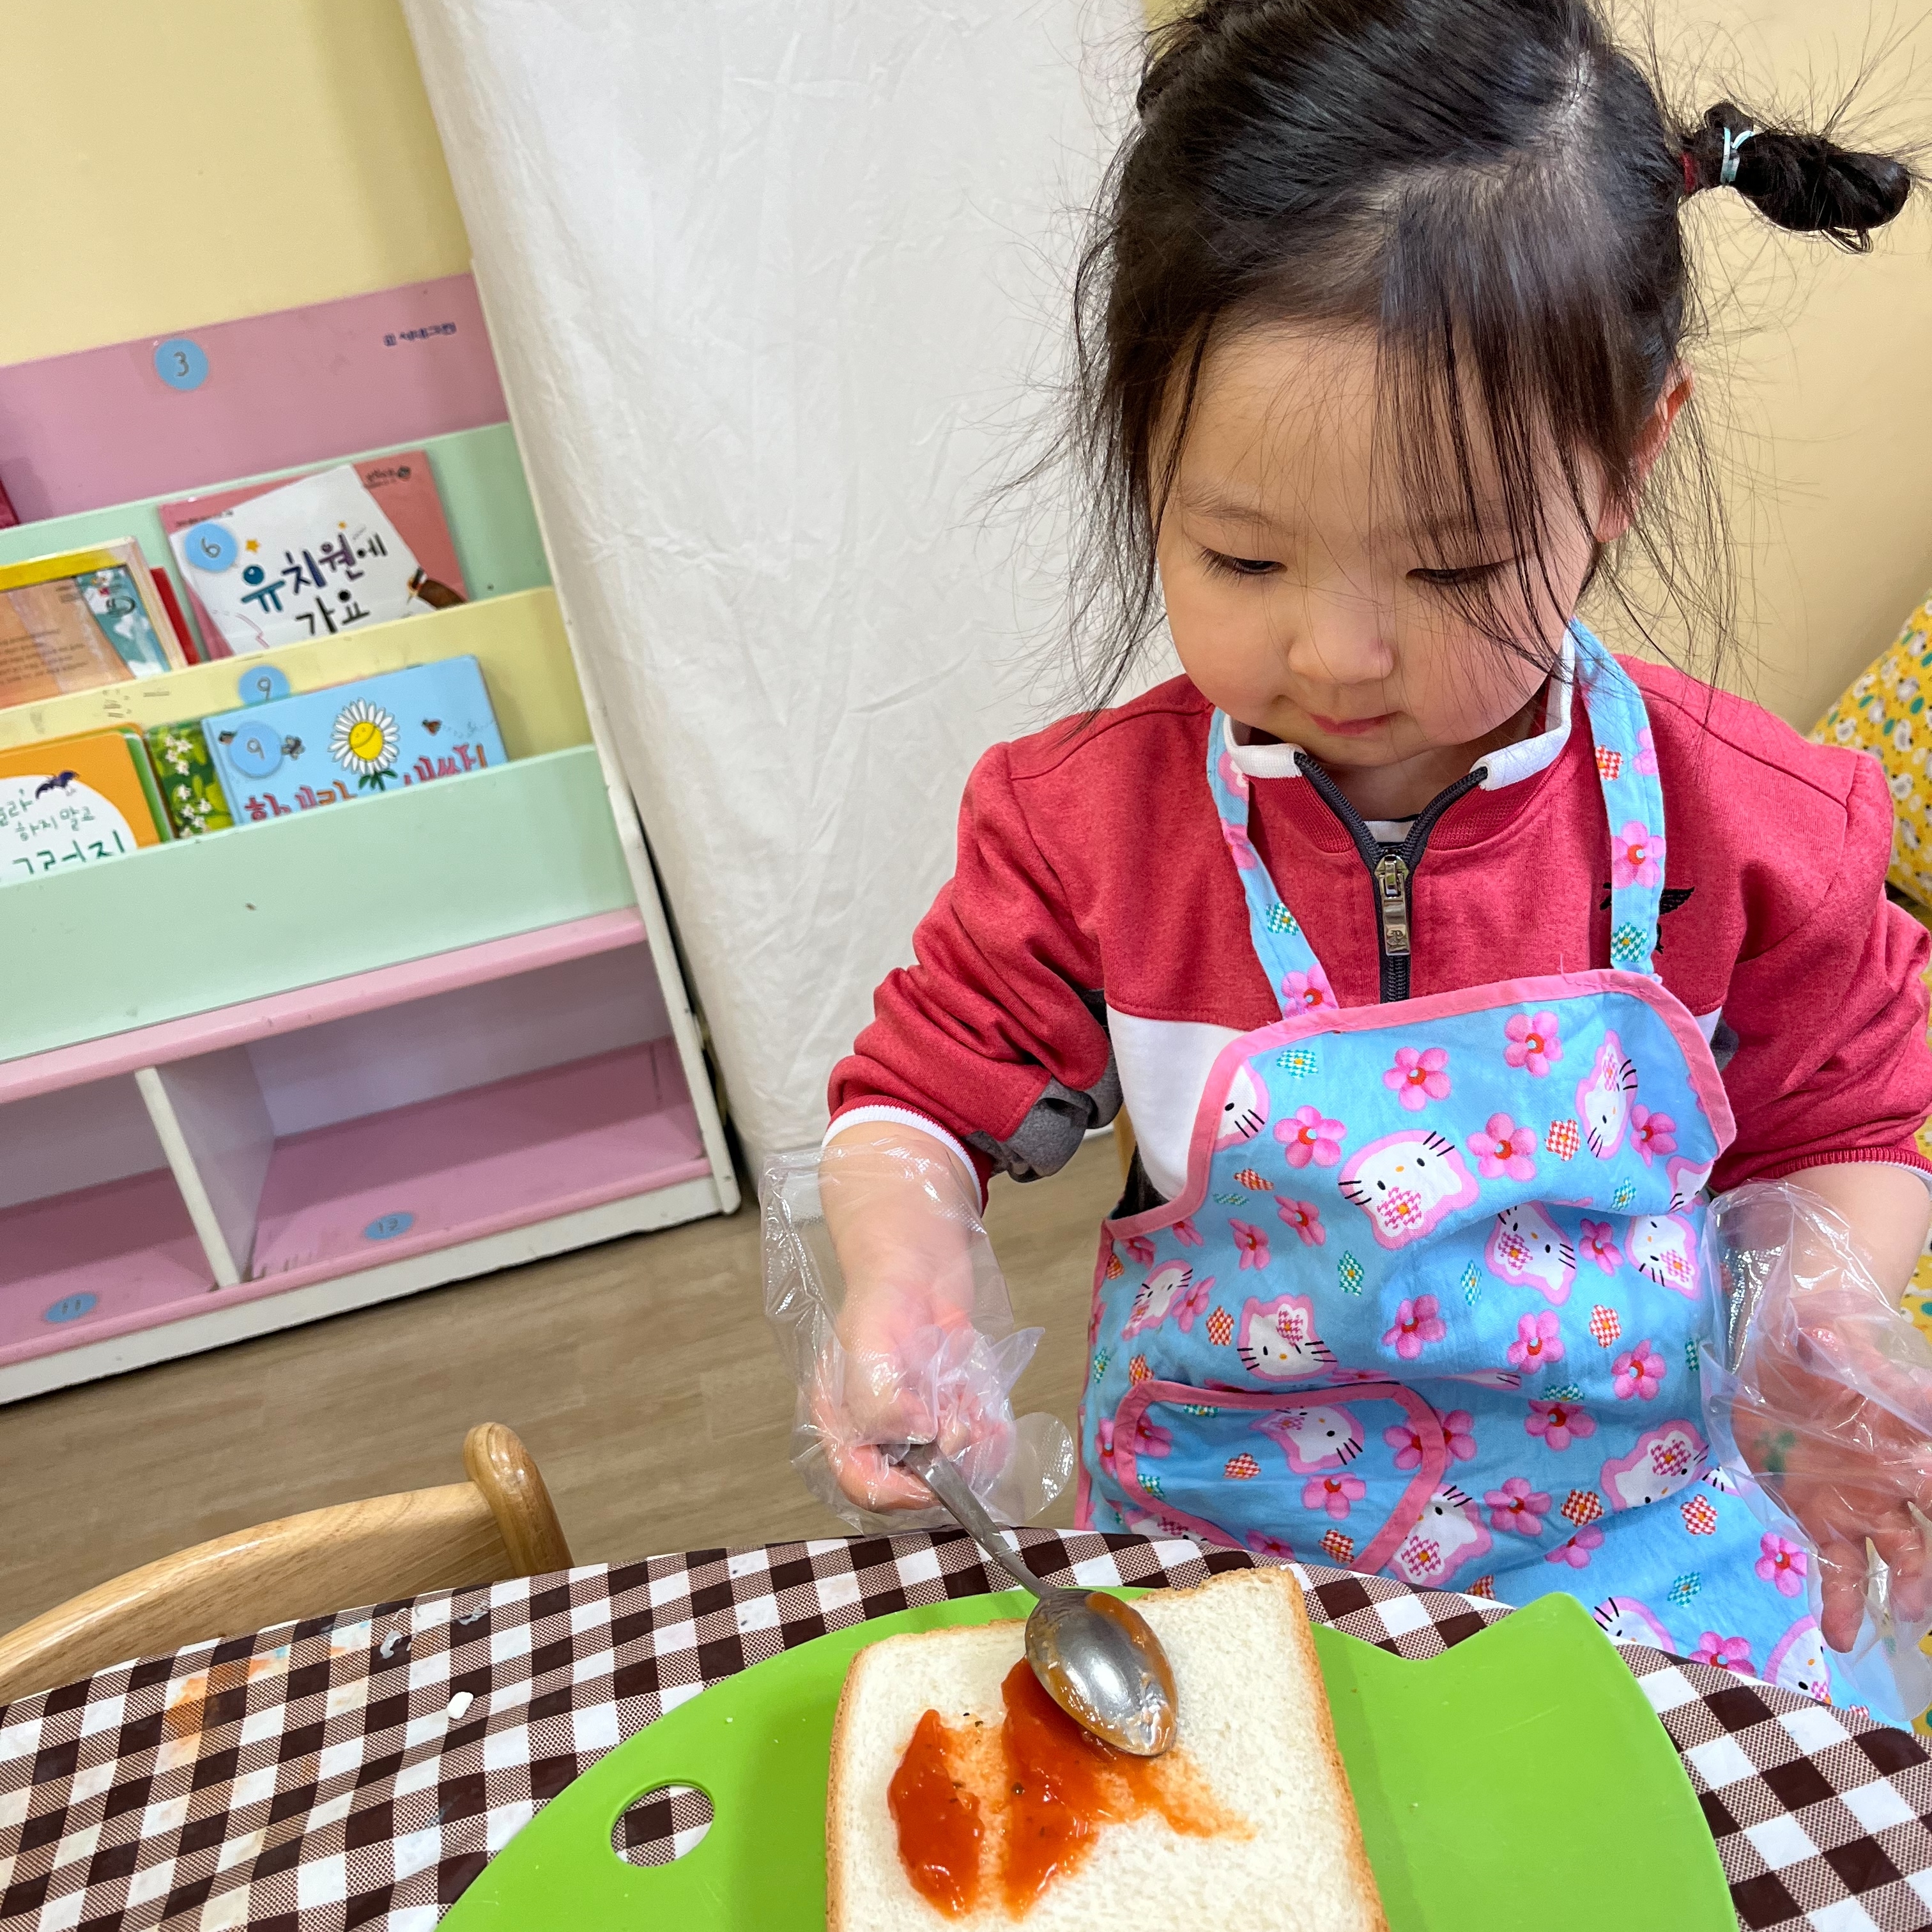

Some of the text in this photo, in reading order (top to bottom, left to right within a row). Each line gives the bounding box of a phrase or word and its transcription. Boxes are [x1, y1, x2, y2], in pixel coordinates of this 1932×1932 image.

[173, 351, 189, 377] 3
[200, 536, 222, 558] 6
[241, 532, 388, 613] 유치원에
[295, 589, 371, 635] 가요
[257, 676, 271, 702] 9
[247, 738, 265, 761] 9
[15, 815, 58, 842] 하지
